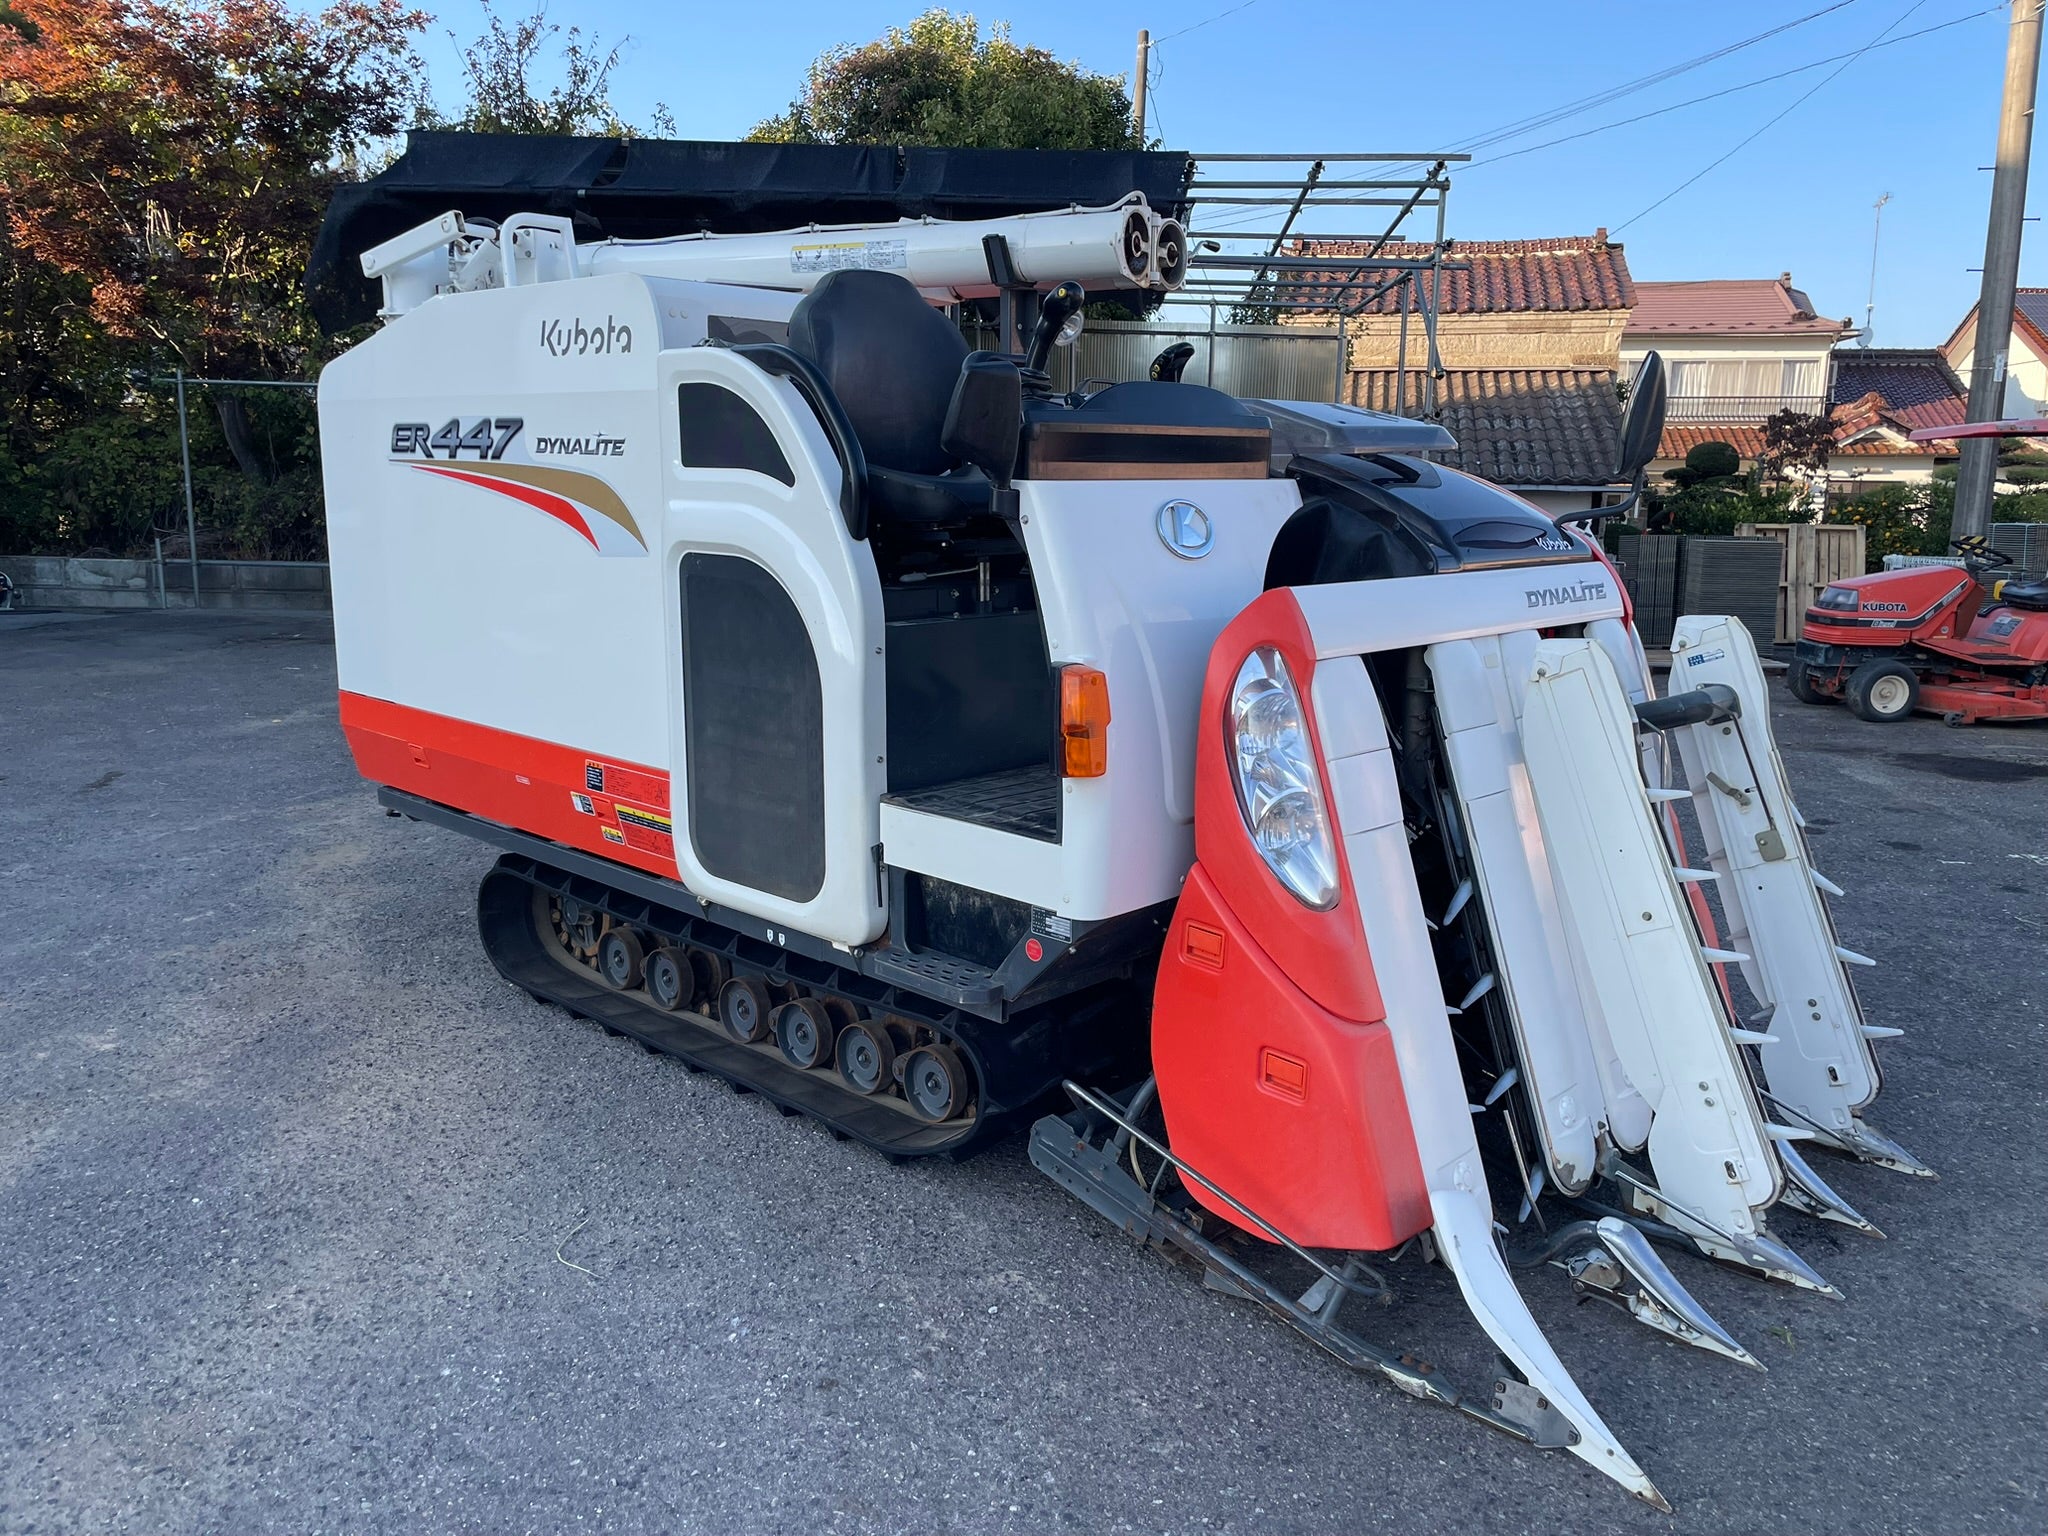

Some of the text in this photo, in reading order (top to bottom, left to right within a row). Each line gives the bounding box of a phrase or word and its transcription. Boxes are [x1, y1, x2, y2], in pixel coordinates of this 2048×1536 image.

[540, 315, 632, 357] Kubota
[535, 434, 627, 456] DYNALITE
[1535, 537, 1572, 551] Kubota
[1525, 581, 1607, 608] DYNALITE
[1862, 602, 1908, 613] KUBOTA
